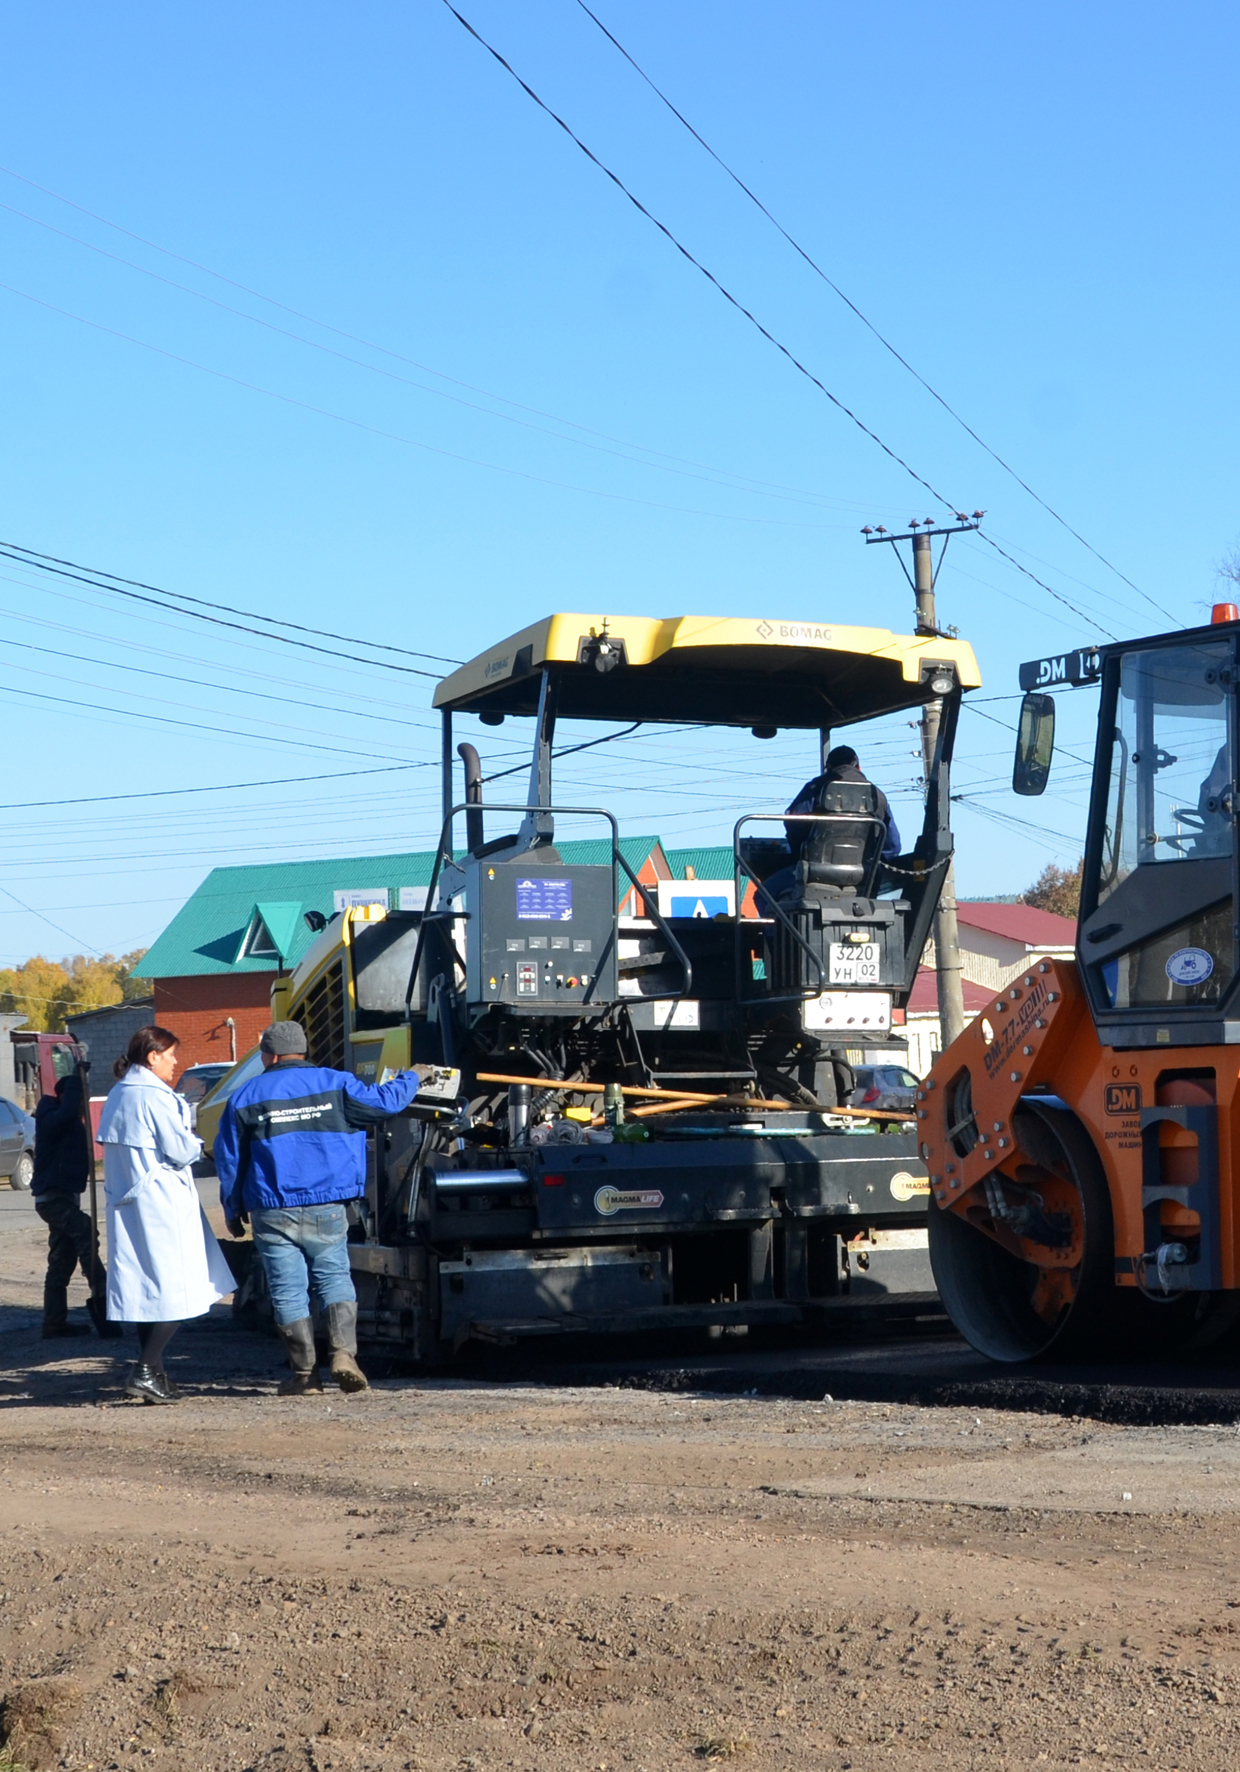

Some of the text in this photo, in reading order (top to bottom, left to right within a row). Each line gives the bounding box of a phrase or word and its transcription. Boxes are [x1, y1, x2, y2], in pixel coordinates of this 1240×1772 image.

[780, 625, 832, 641] BOMAG
[837, 945, 873, 961] 3220
[861, 964, 876, 976] 02
